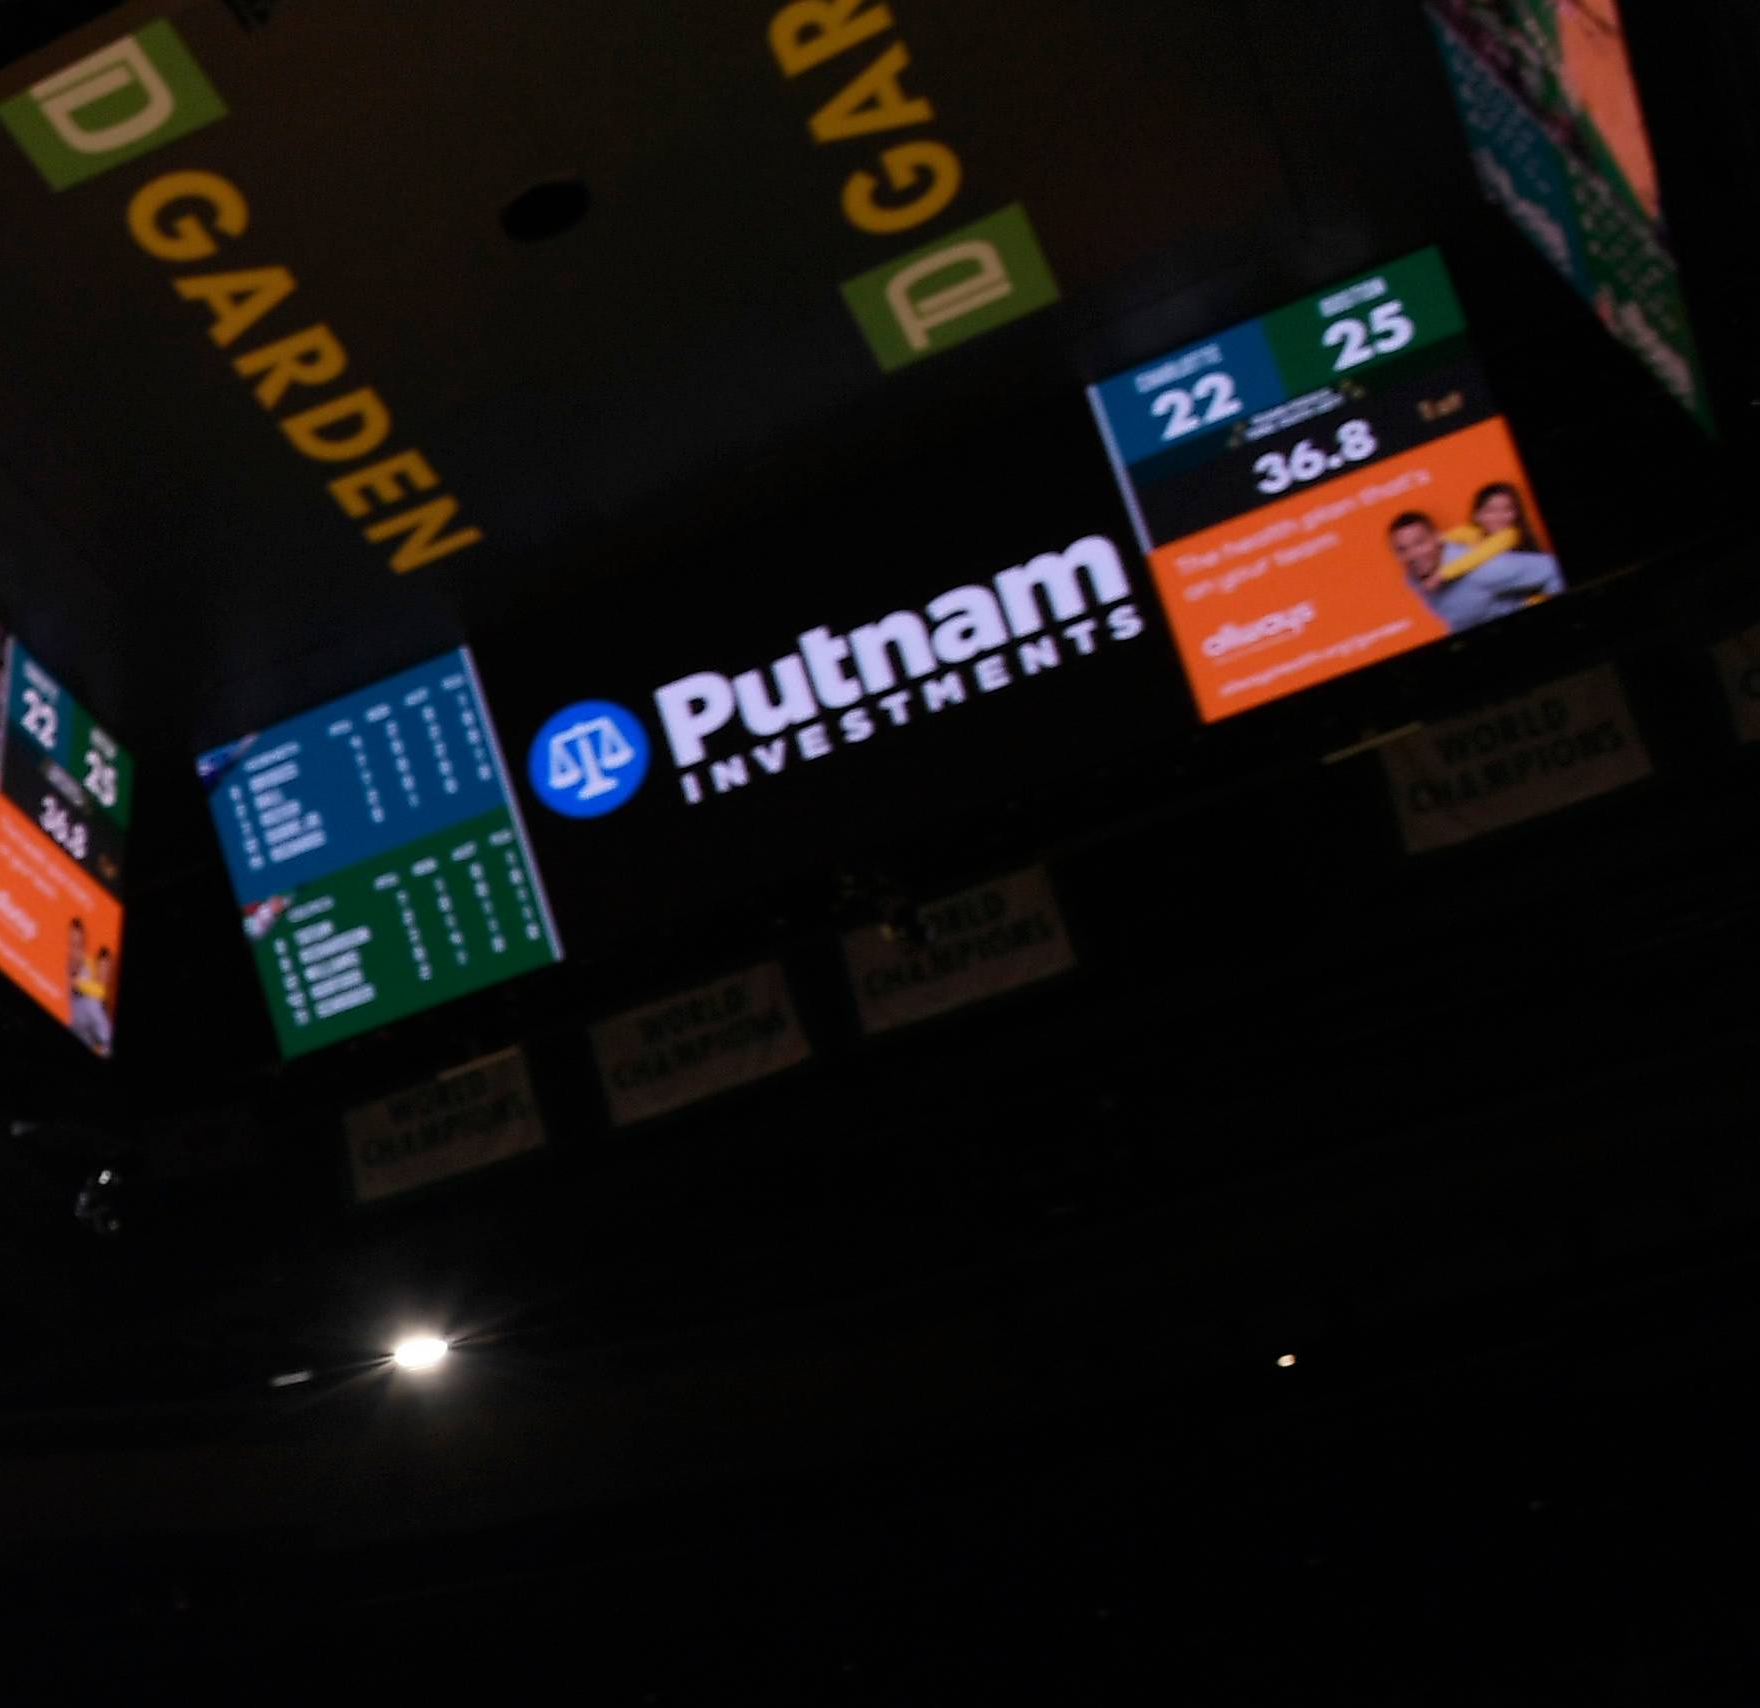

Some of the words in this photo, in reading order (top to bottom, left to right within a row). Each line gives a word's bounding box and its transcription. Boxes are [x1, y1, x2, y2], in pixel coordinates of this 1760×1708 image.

[127, 168, 483, 574] GARDEN
[1322, 299, 1416, 373] 25
[1150, 371, 1243, 440] 22
[1253, 419, 1377, 494] 36.8
[653, 533, 1133, 768] Putnam
[679, 604, 1147, 804] INVESTMENTS
